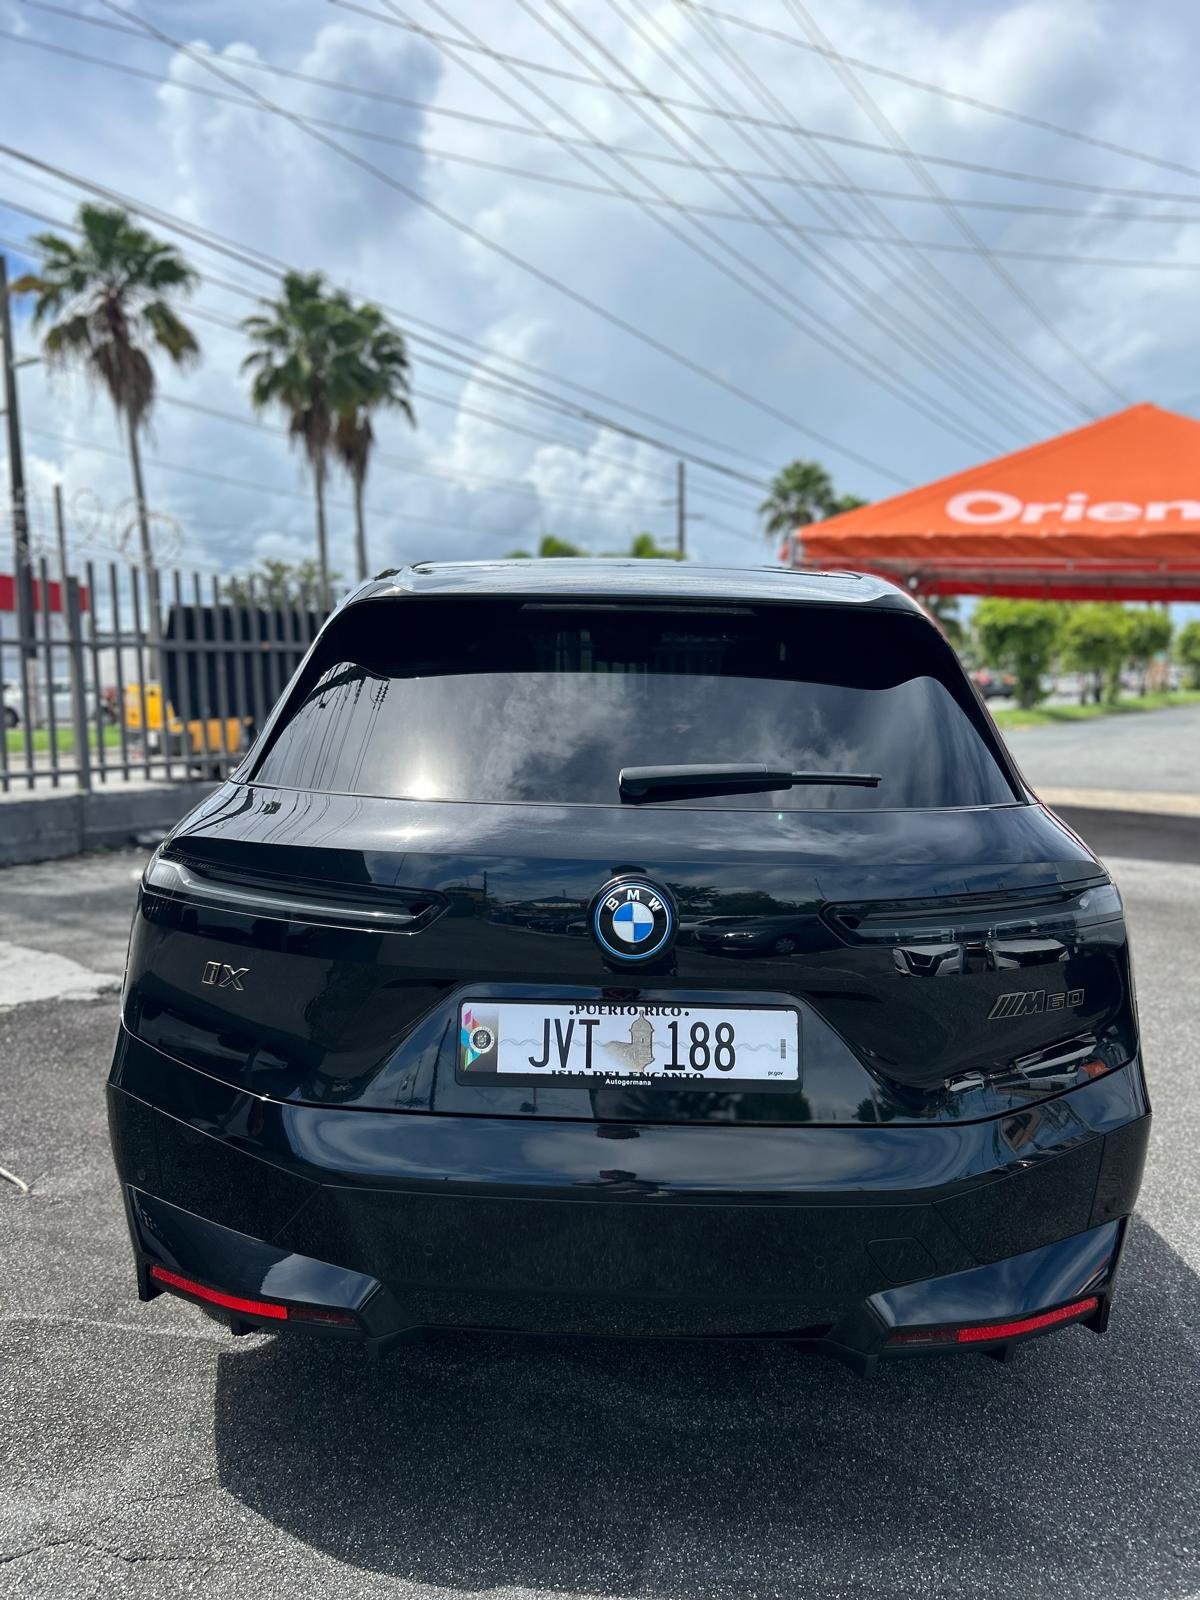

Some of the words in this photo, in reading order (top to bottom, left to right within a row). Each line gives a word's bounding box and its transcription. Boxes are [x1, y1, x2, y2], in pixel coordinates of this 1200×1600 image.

[605, 889, 663, 912] BMW
[575, 1005, 638, 1015] PUERTO
[645, 1006, 682, 1016] RICO
[528, 1018, 600, 1068] JVT
[664, 1021, 736, 1071] 188
[605, 1078, 652, 1086] Autogermana
